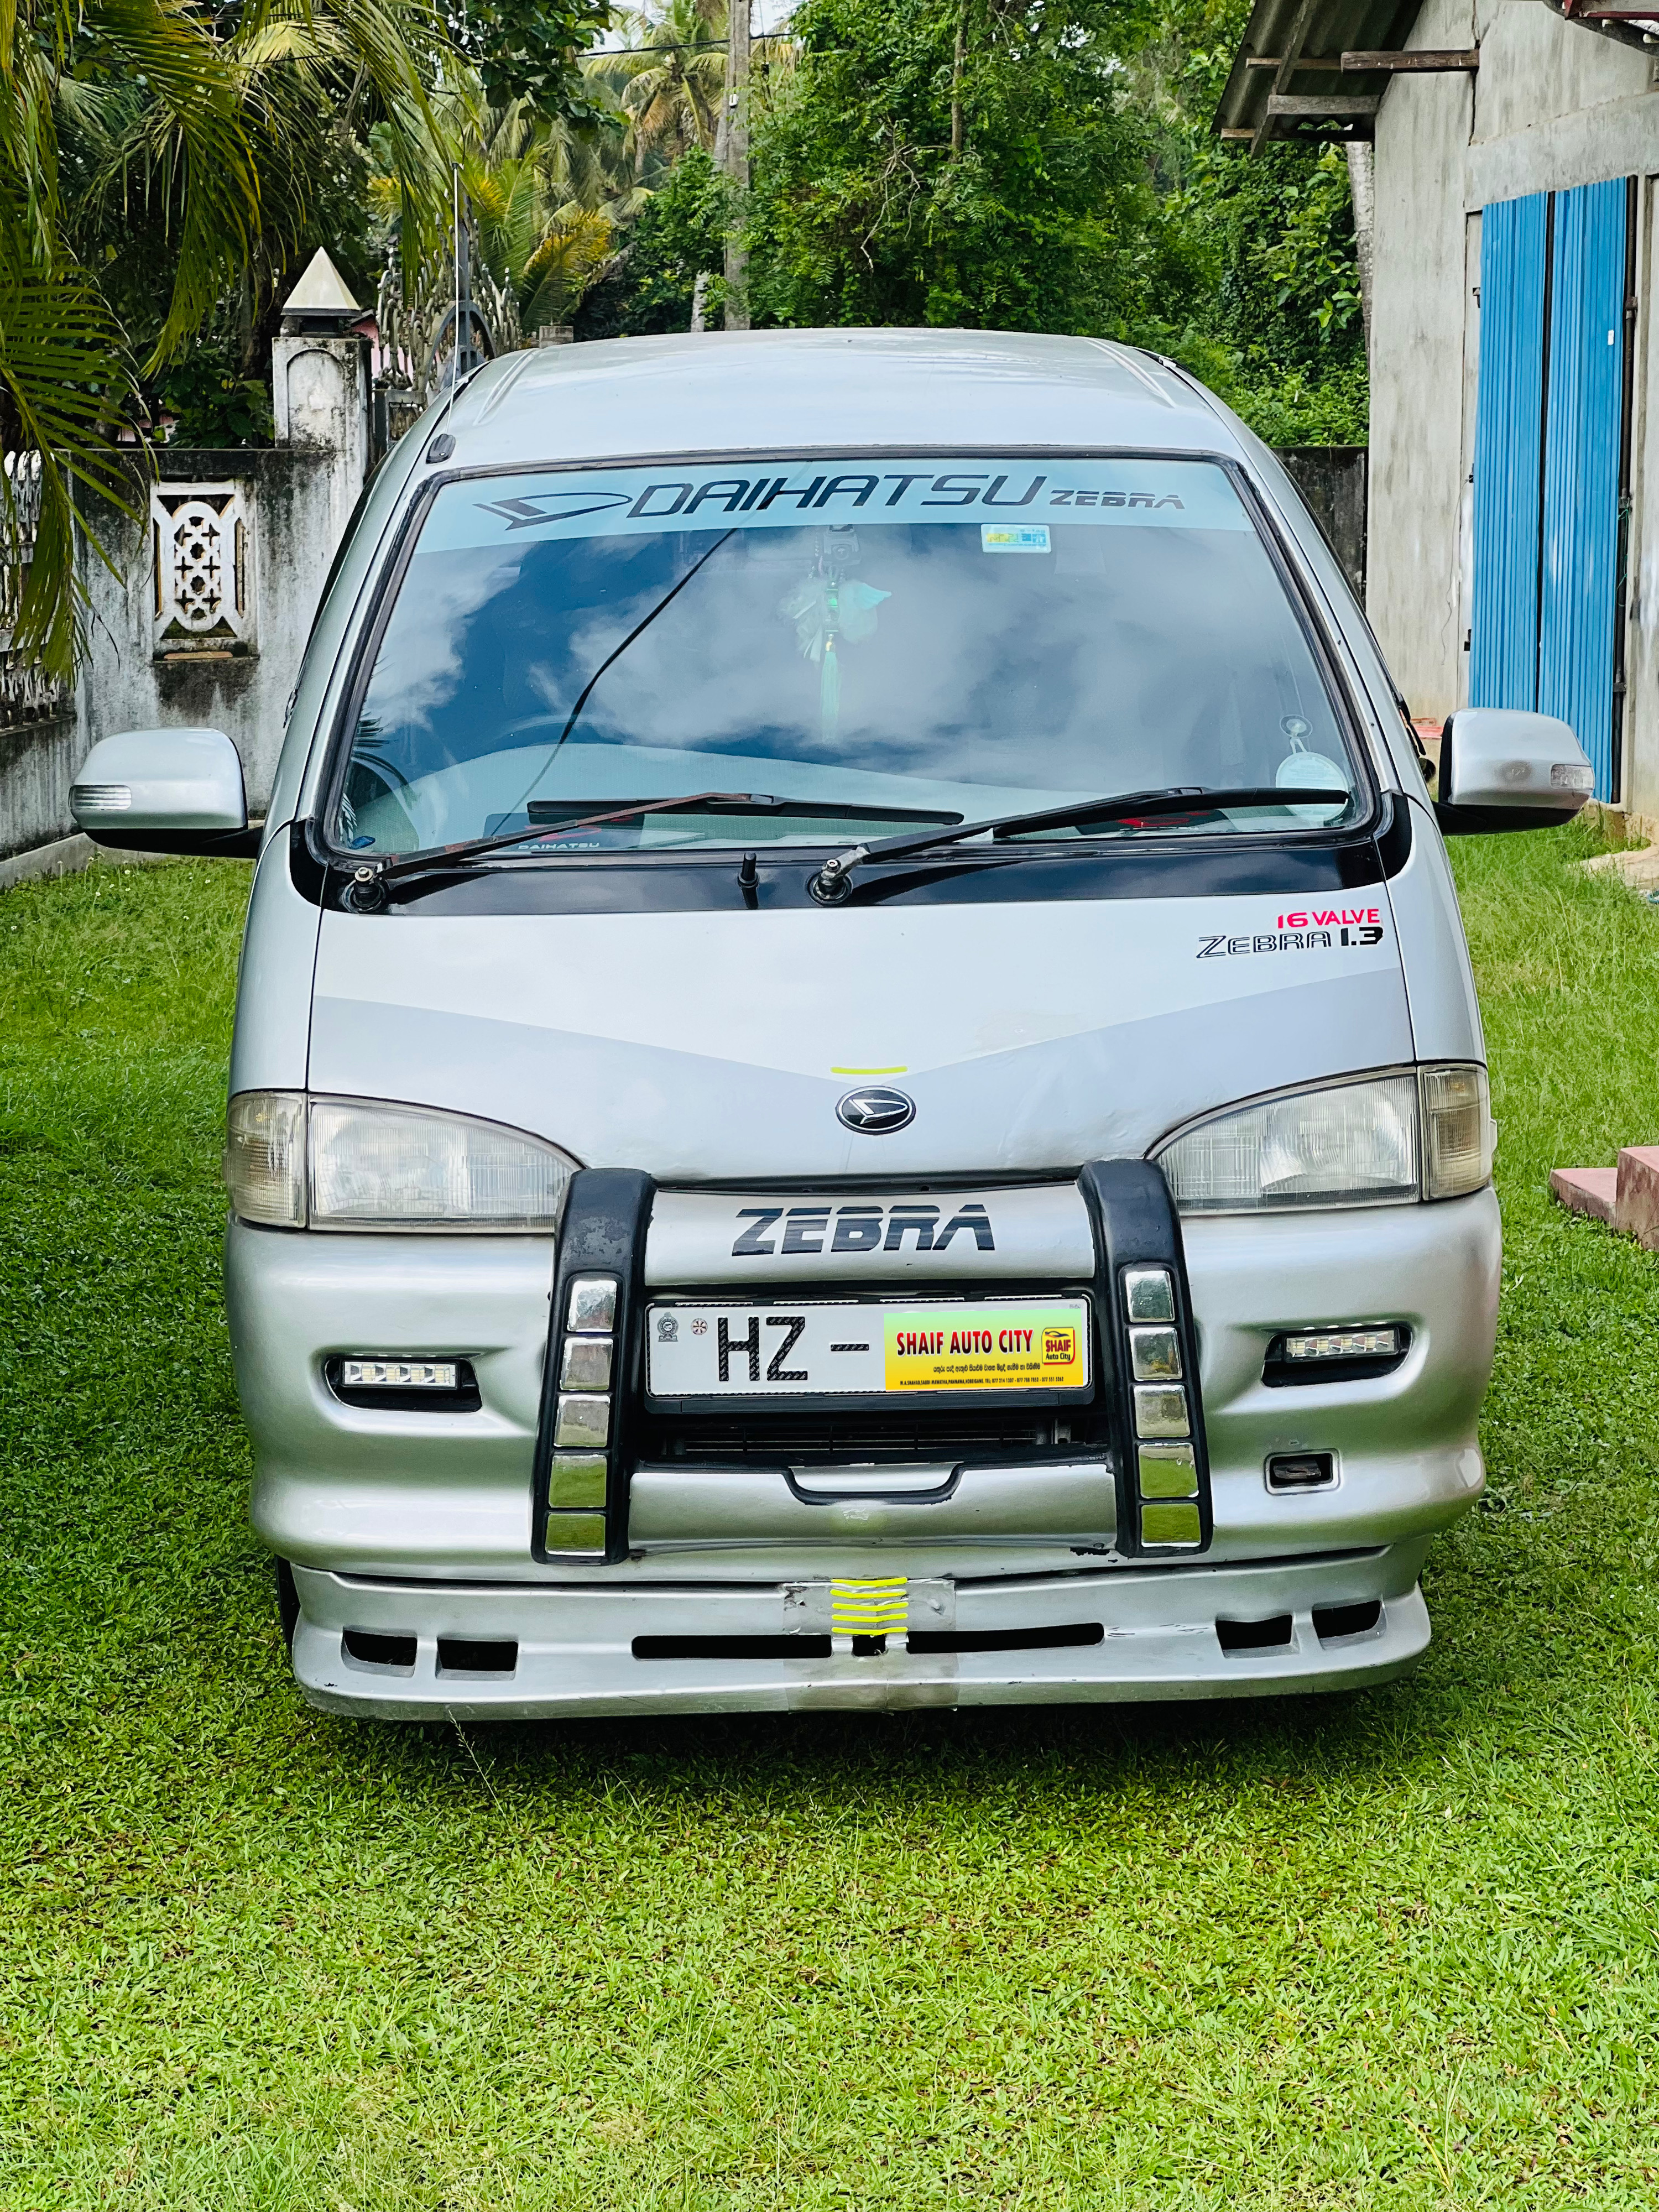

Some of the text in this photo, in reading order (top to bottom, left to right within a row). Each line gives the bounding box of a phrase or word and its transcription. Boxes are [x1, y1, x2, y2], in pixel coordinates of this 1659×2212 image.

[627, 474, 1185, 518] DAIHATSU ZEBRA
[1277, 909, 1380, 929] 16 VALVE
[1196, 926, 1384, 958] ZEBRA 1.3
[732, 1204, 996, 1256] ZEBRA
